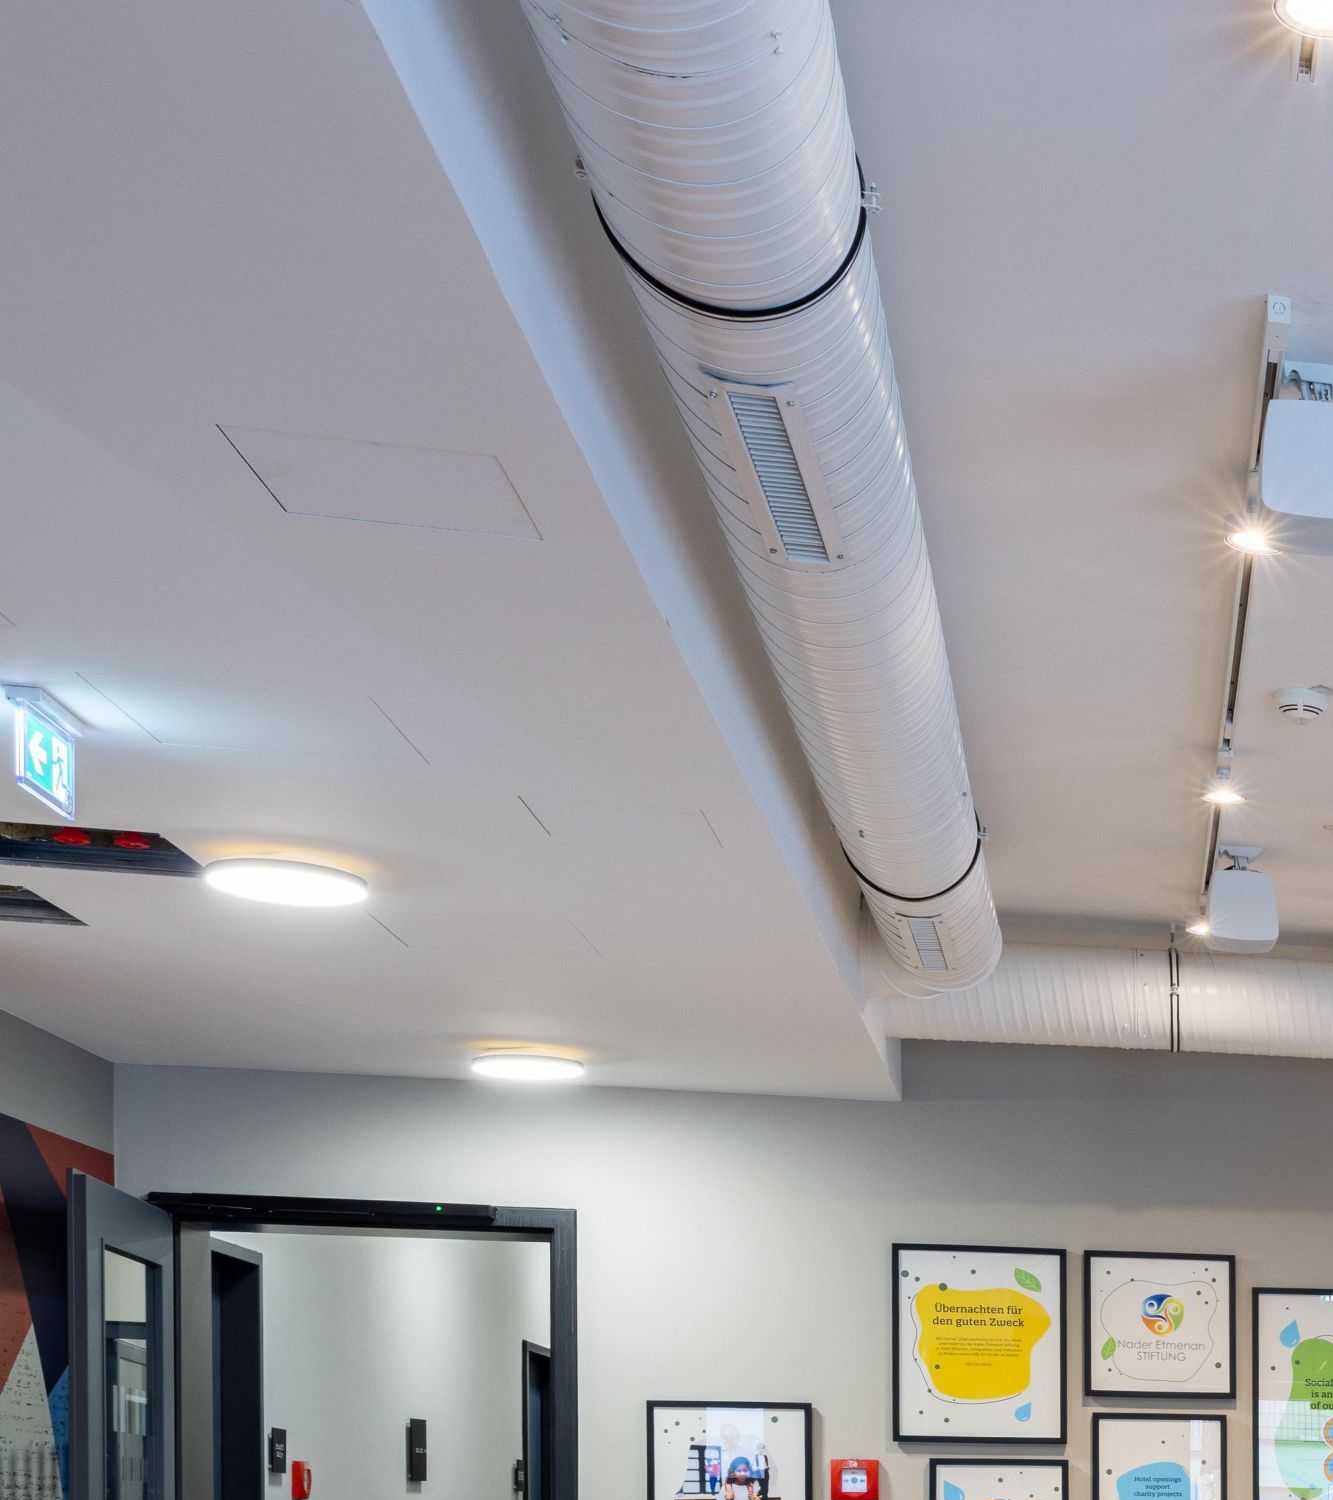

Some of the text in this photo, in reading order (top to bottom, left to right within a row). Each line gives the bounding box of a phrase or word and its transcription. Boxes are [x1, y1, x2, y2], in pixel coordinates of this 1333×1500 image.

[935, 1302, 1023, 1315] Übernachten für
[932, 1317, 1025, 1328] den guten Zweck
[1117, 1340, 1206, 1351] Nader Etmenan
[1136, 1351, 1187, 1362] STIFTUNG
[1305, 1378, 1333, 1388] Social
[1311, 1390, 1319, 1398] is
[1321, 1391, 1333, 1399] an
[1310, 1402, 1320, 1410] of
[1152, 1476, 1182, 1484] openings
